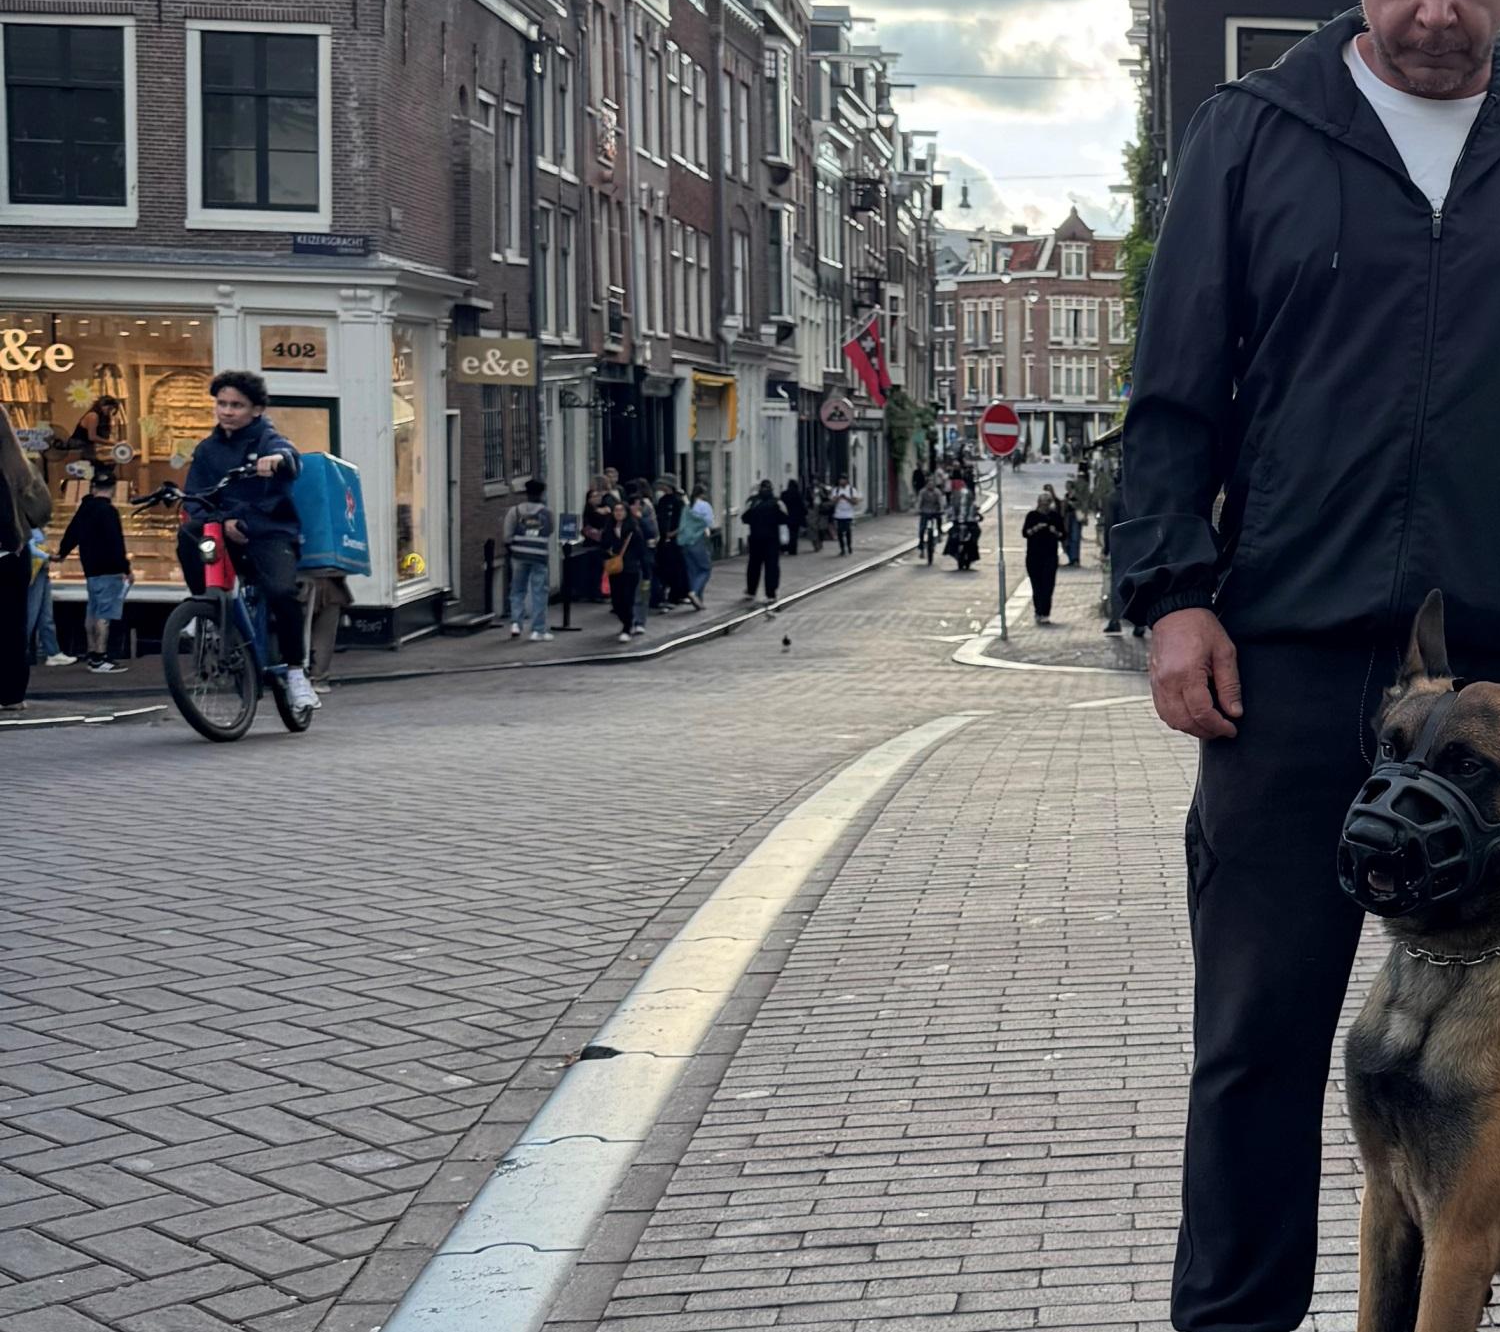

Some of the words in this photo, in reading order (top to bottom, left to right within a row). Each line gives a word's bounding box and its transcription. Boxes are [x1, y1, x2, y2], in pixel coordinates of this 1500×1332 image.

[296, 234, 364, 247] KEIZERSGRACHT
[272, 342, 316, 358] 402
[461, 348, 529, 377] e&e
